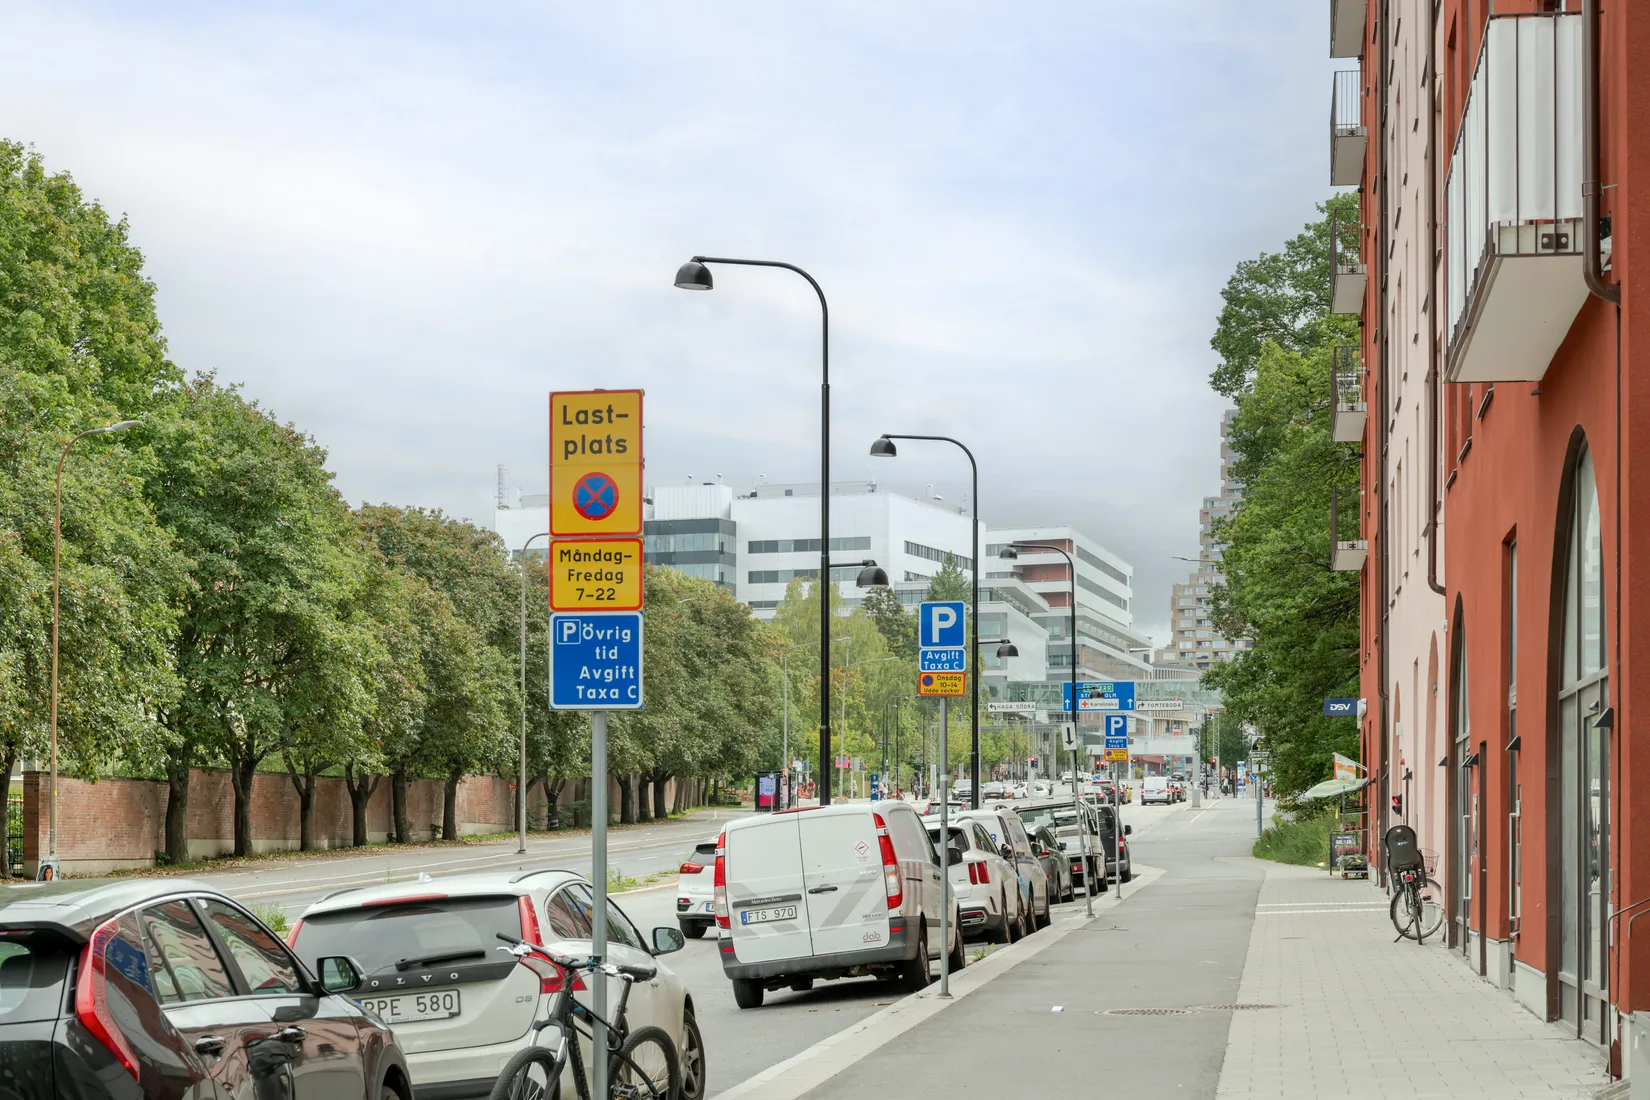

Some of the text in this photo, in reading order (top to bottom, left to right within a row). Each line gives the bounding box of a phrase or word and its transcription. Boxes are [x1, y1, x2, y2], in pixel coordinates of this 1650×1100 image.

[562, 405, 629, 425] Last-
[564, 434, 628, 460] plats
[559, 549, 632, 565] Måndag-
[567, 568, 624, 584] Fredag
[575, 588, 616, 601] 7-22
[562, 622, 631, 642] P Övrig
[931, 606, 957, 643] P
[595, 646, 618, 660] tid
[926, 650, 959, 662] Avgift
[923, 661, 960, 670] Taxa C
[579, 665, 634, 683] Avgift
[576, 685, 637, 699] Taxa C
[1330, 703, 1351, 711] DSV
[1110, 716, 1124, 735] P
[747, 907, 794, 922] FTS 970
[862, 930, 881, 941] dab
[371, 972, 459, 988] OLVO
[416, 993, 454, 1014] 580
